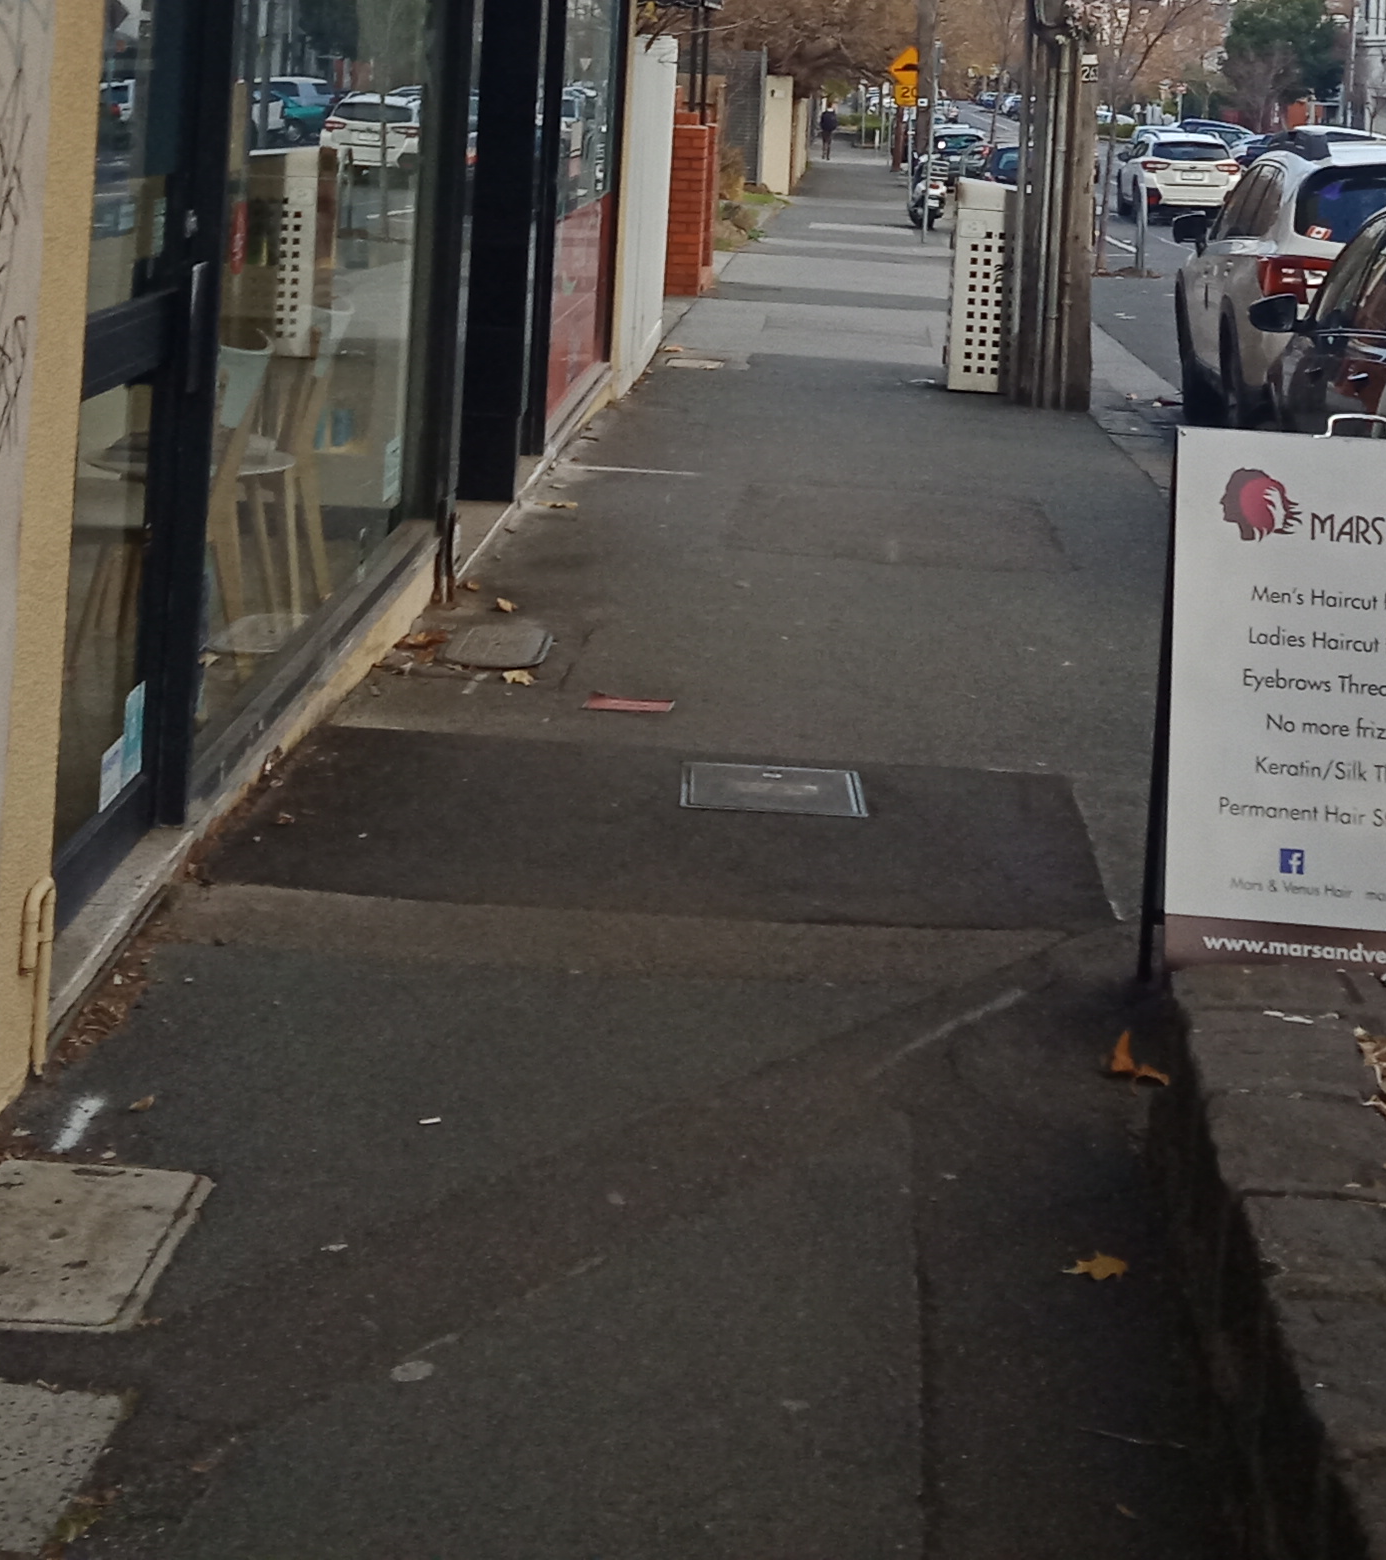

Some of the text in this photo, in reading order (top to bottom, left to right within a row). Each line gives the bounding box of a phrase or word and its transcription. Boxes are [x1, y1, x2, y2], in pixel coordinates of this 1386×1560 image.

[1310, 511, 1386, 546] MARS
[1250, 585, 1305, 606] Men's
[1310, 589, 1378, 611] Haircut
[1248, 625, 1306, 648] Ladies
[1312, 631, 1380, 654] Haircut
[1242, 668, 1333, 693] Eyebrows
[1265, 713, 1296, 734] No
[1301, 721, 1351, 738] more
[1254, 754, 1367, 782] Keratin/Silk
[1218, 795, 1319, 823] Permanent
[1324, 803, 1367, 826] Hair
